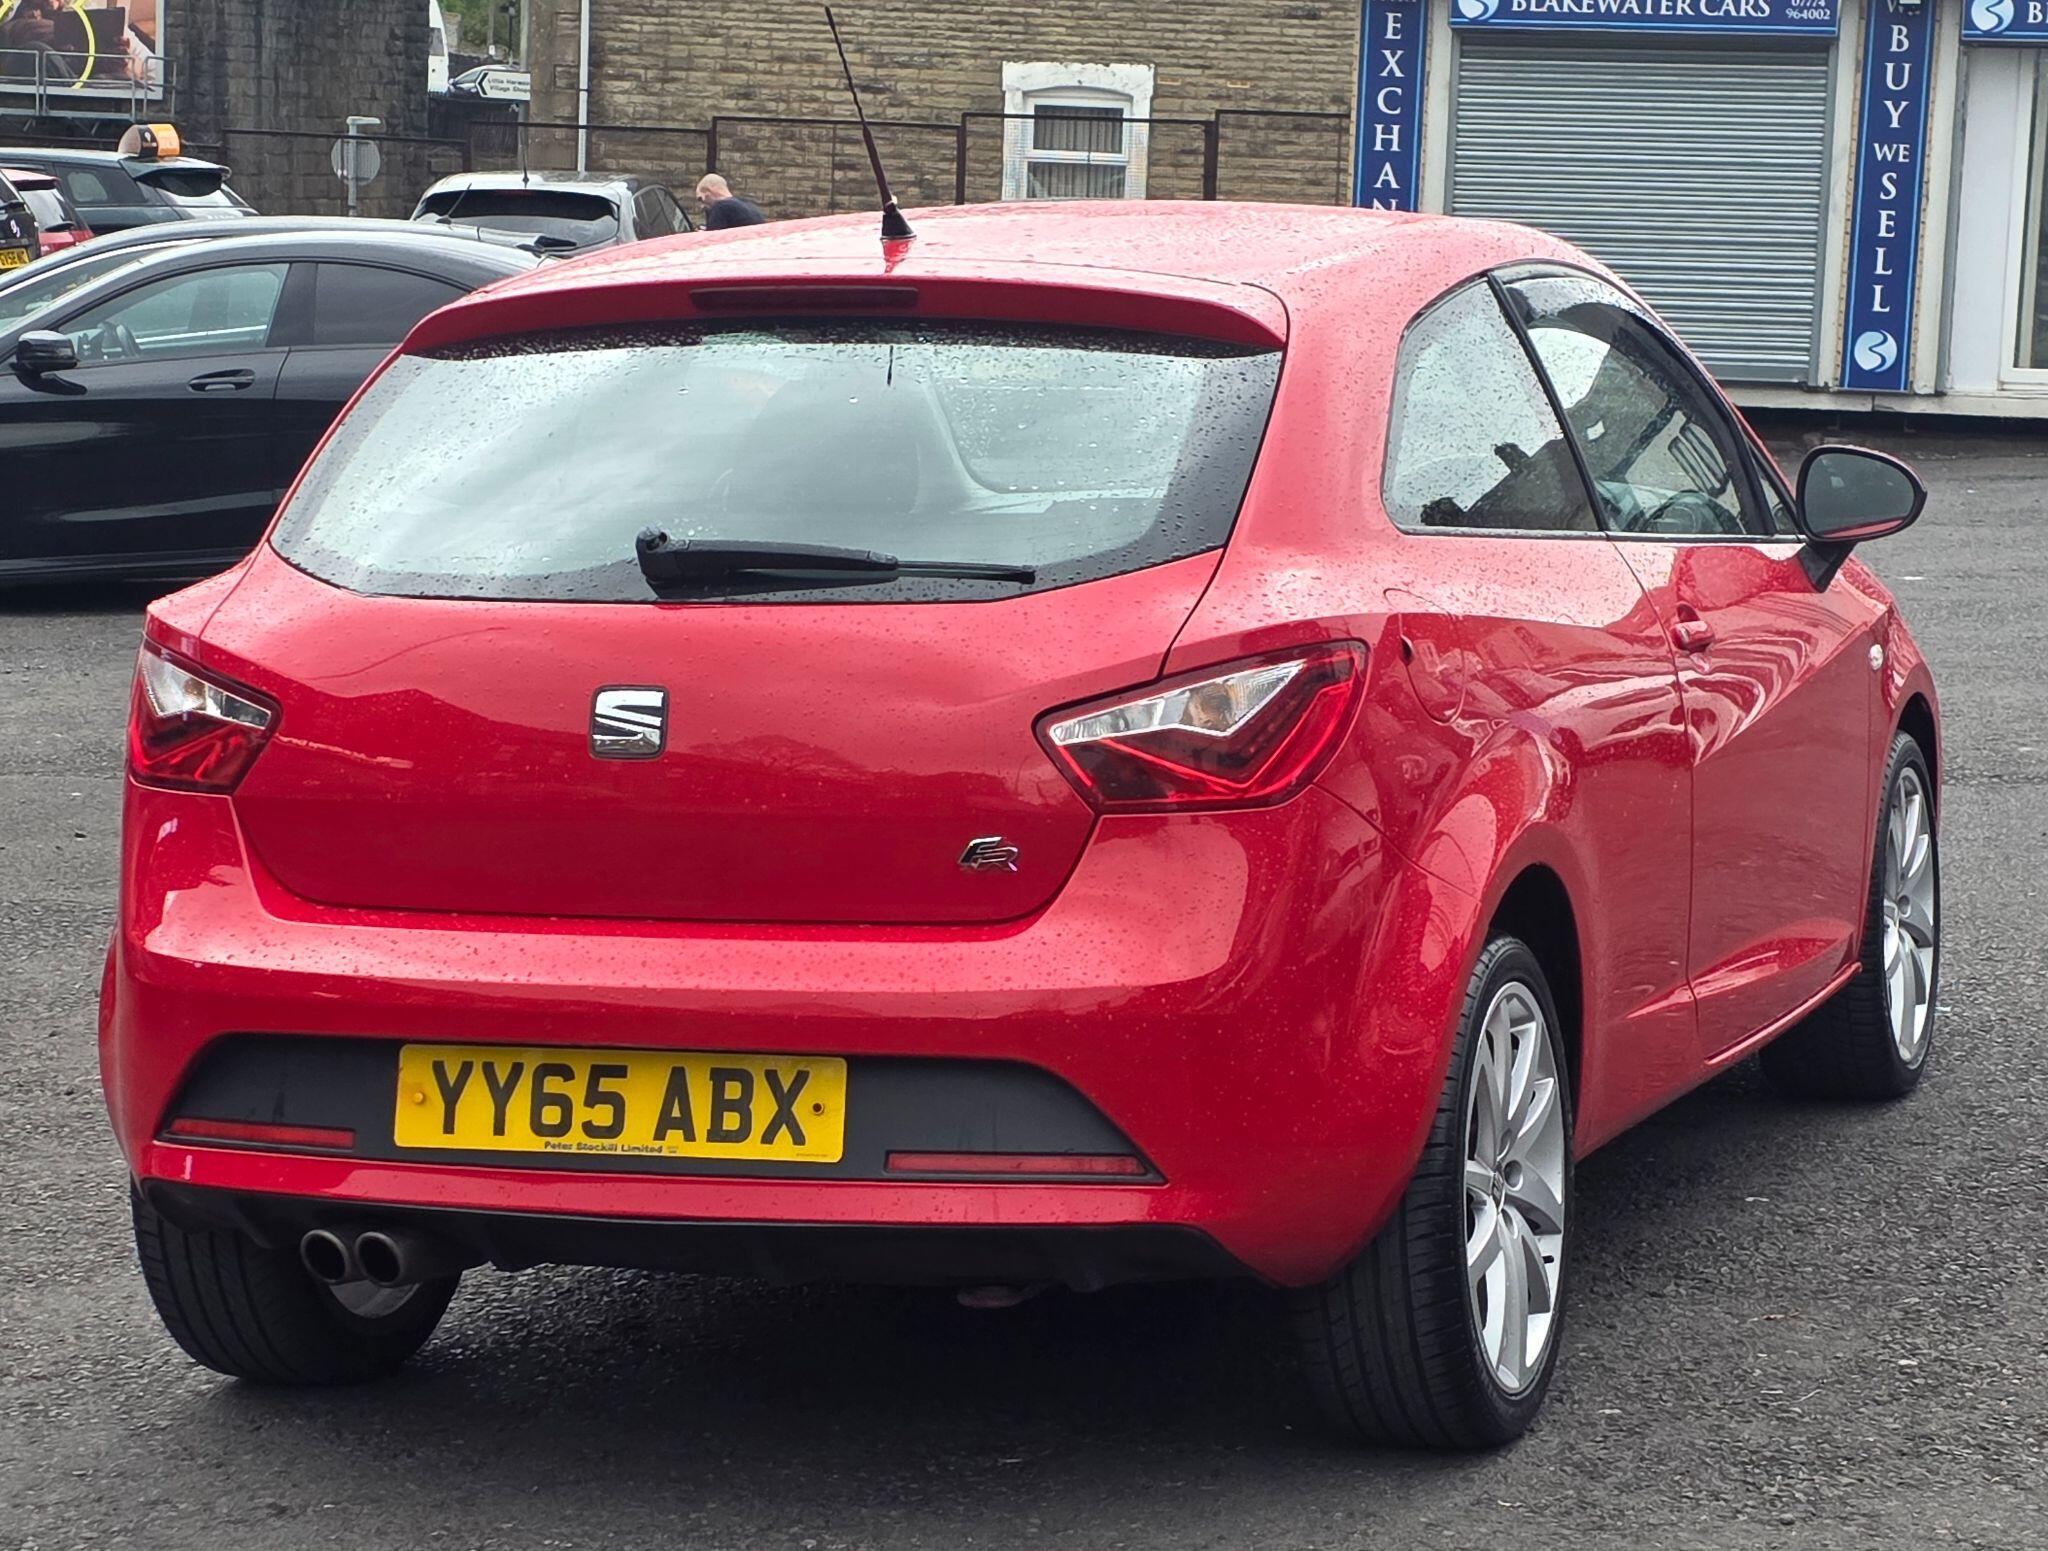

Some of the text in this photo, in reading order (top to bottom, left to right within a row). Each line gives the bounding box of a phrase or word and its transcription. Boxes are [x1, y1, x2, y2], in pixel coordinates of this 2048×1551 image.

[1511, 0, 1771, 17] BLAKEWATER CARS
[1785, 8, 1830, 20] 964002
[1884, 24, 1912, 129] BUY
[1873, 143, 1910, 162] WE
[1871, 172, 1897, 313] SELL
[432, 1060, 810, 1146] YY65 ABX
[621, 1144, 663, 1154] Limited
